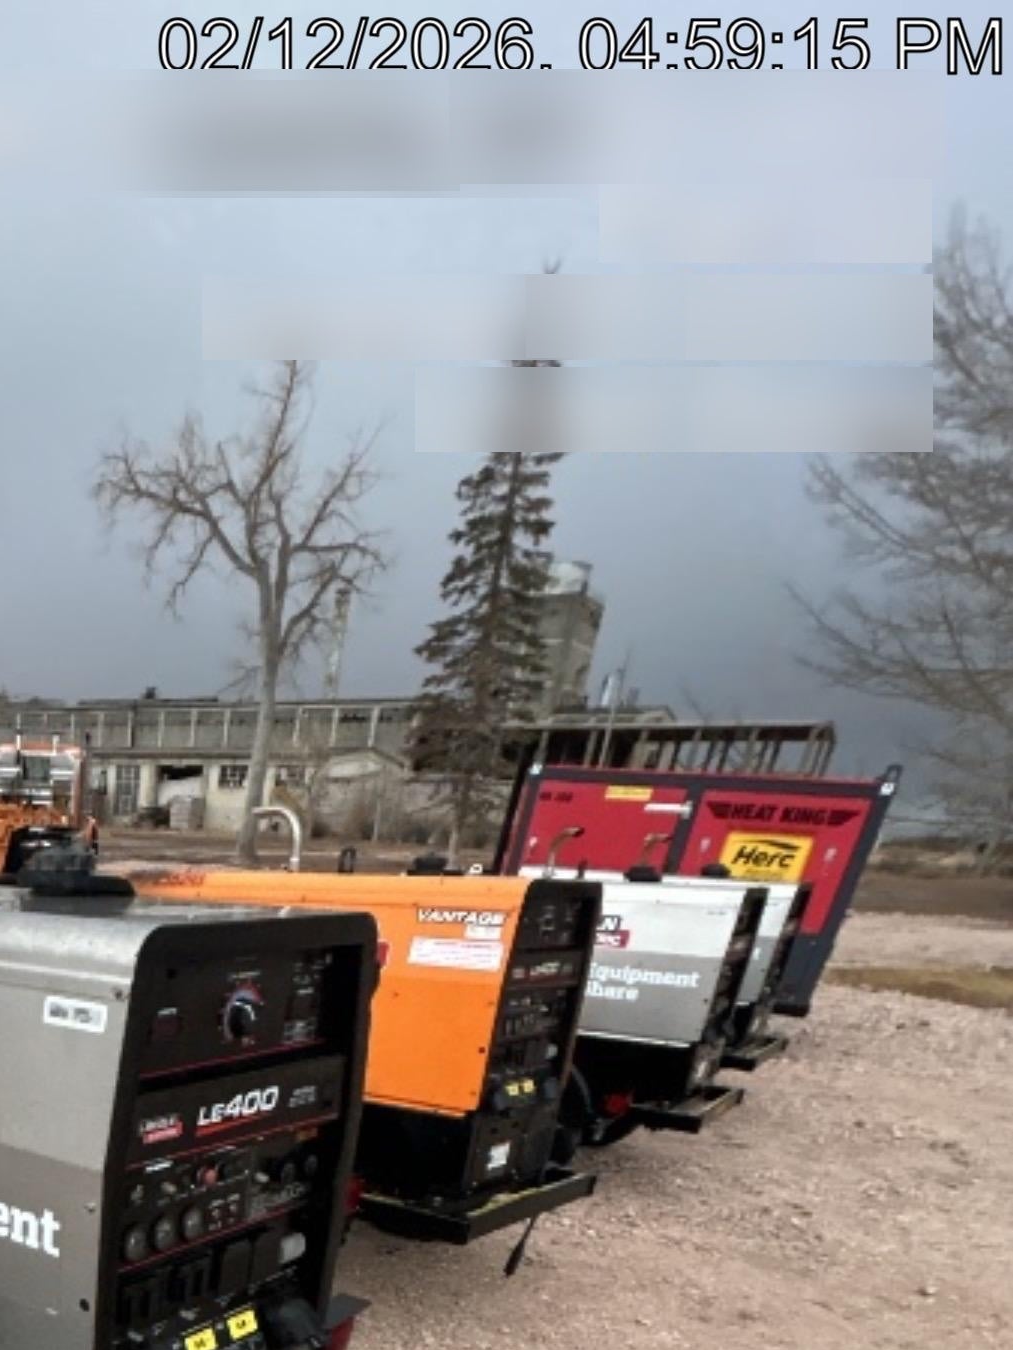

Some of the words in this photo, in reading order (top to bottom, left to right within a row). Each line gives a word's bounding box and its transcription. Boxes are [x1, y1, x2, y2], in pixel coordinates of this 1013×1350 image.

[731, 803, 778, 821] HEAT
[779, 807, 826, 825] KING
[731, 845, 795, 869] Herc
[418, 908, 506, 925] VANTAGE
